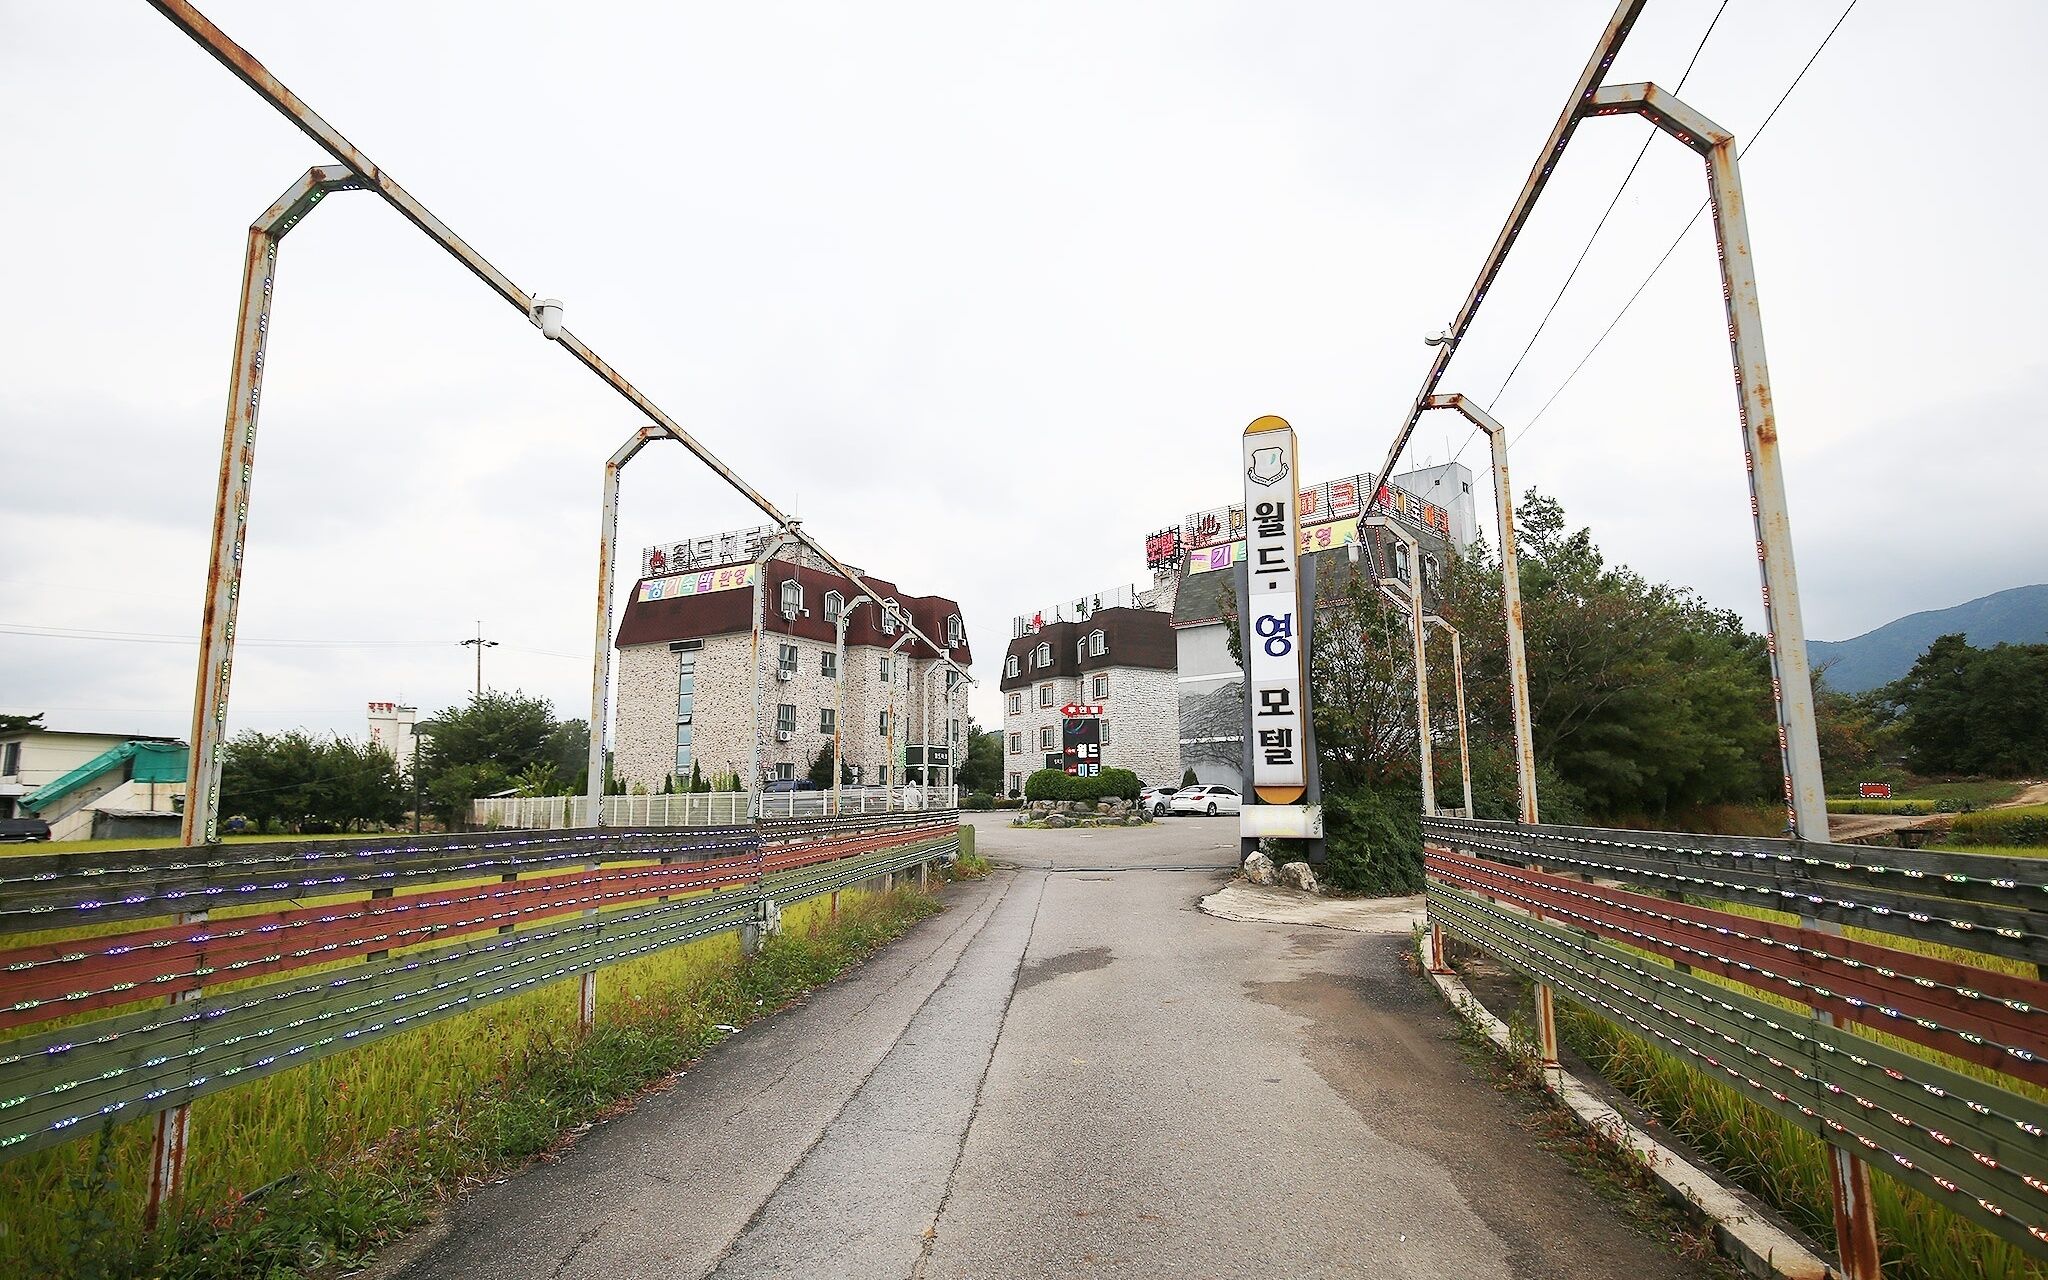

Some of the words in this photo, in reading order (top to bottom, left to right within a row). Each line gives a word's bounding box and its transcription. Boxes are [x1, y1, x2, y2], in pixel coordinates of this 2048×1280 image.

[648, 571, 715, 600] 장기숙박
[719, 568, 746, 588] 환영
[1256, 613, 1292, 656] 영
[1256, 688, 1295, 765] 모텔
[1077, 743, 1098, 758] 월드
[1077, 763, 1099, 777] 미로
